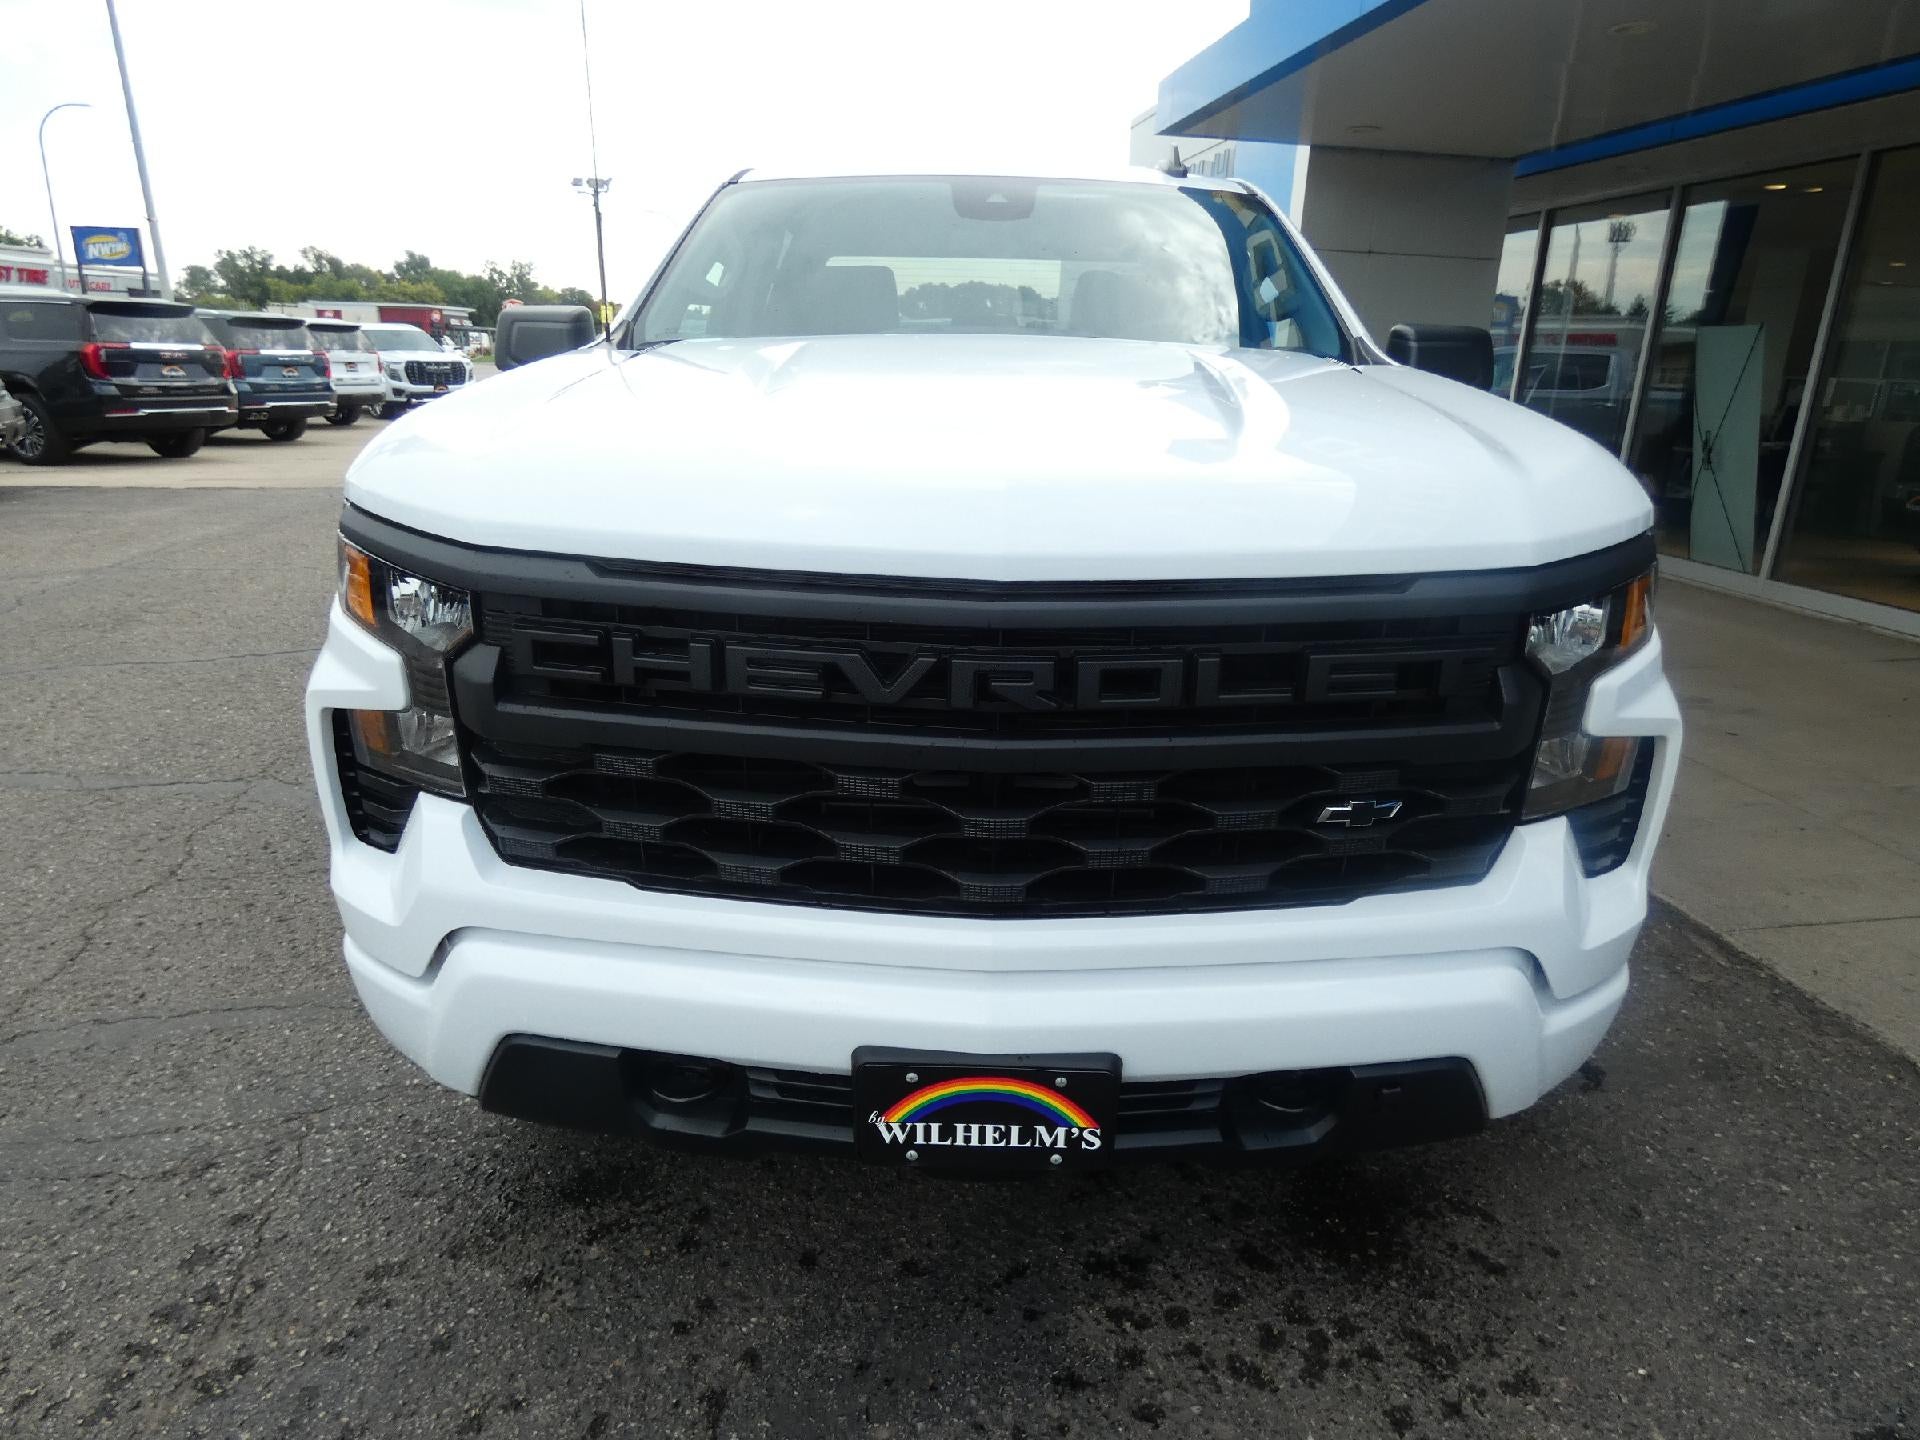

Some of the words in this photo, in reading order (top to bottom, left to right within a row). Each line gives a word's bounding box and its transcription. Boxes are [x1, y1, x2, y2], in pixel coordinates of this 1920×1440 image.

[17, 267, 49, 284] TIRE
[511, 622, 1496, 709] CHEVROLET
[868, 1110, 887, 1125] by
[875, 1122, 1102, 1150] WILHELM'S
